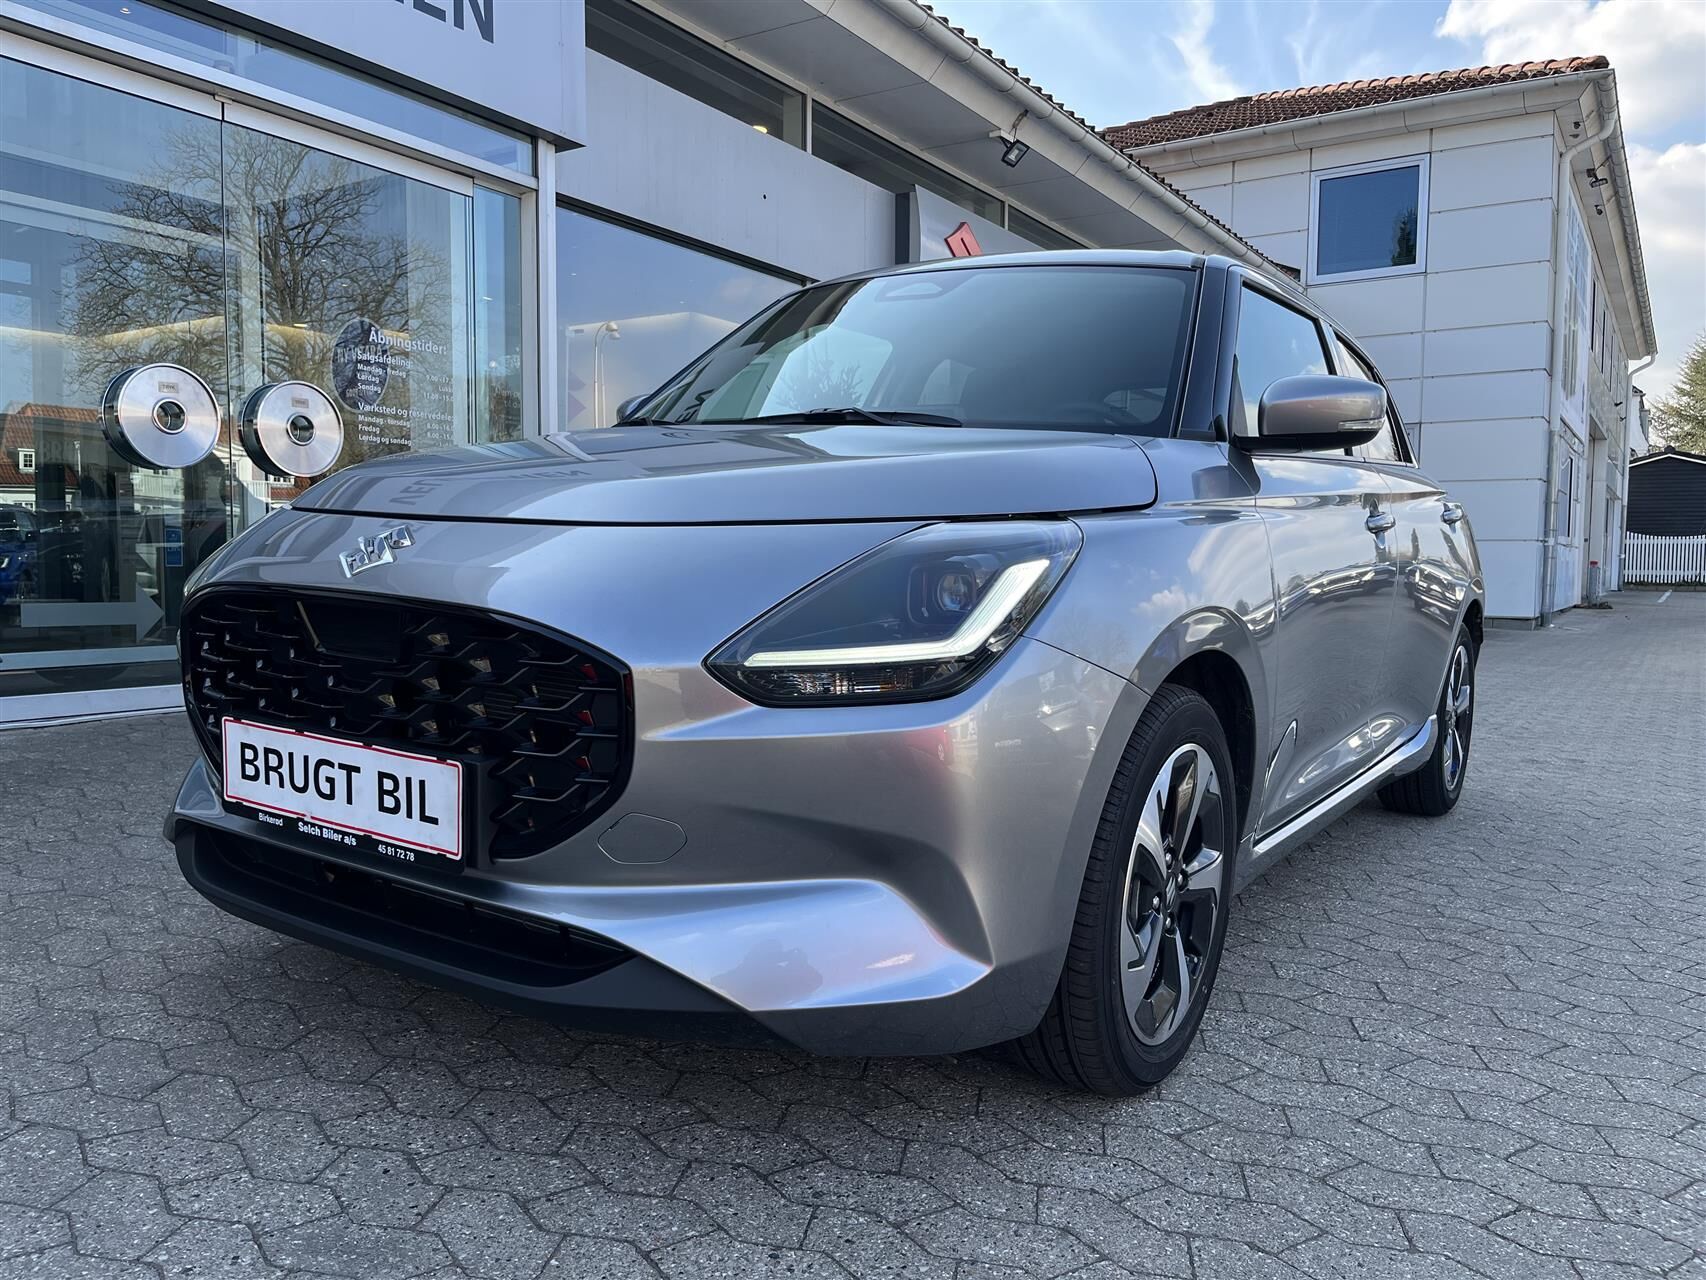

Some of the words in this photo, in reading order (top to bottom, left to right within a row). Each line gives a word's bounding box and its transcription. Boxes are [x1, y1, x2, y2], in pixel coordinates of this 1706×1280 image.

[369, 327, 447, 354] Åbningstider:
[357, 363, 382, 374] Mandag
[358, 402, 396, 414] Værksted
[397, 409, 407, 417] og
[358, 415, 383, 425] Mandag
[358, 423, 380, 434] Fredag
[240, 741, 361, 805] BRUGT
[377, 770, 439, 826] BIL
[298, 821, 321, 837] Selch
[322, 828, 342, 842] Biler
[344, 834, 357, 846] a/s
[378, 844, 387, 854] 45
[387, 846, 395, 856] 81
[396, 848, 405, 859] 72
[406, 851, 415, 861] 78
